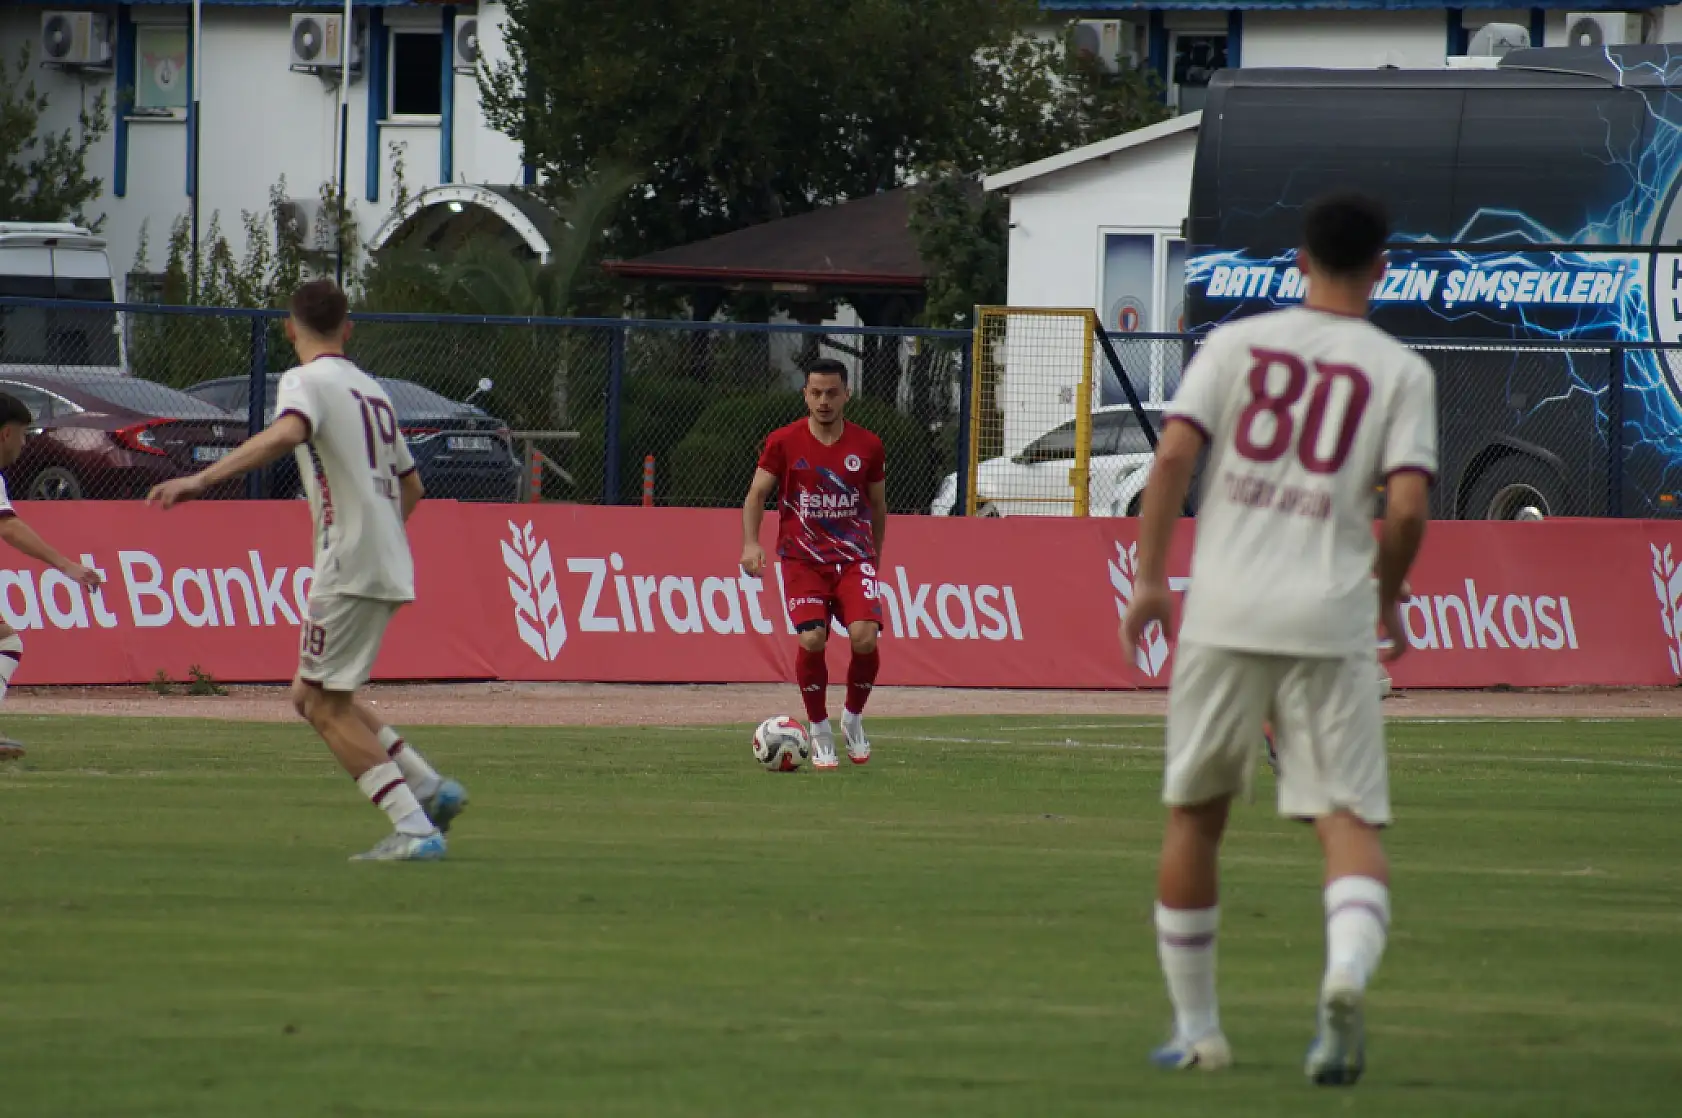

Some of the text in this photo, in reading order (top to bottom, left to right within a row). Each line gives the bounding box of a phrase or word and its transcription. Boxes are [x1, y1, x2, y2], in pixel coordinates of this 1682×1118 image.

[1206, 262, 1626, 309] BATI AİZİN ŞİMŞEKLERİ
[1234, 346, 1372, 474] 80
[799, 493, 860, 508] ESNAF
[117, 550, 317, 628] Bank
[566, 552, 1024, 641] Ziraat nkası
[1371, 578, 1579, 650] ankası
